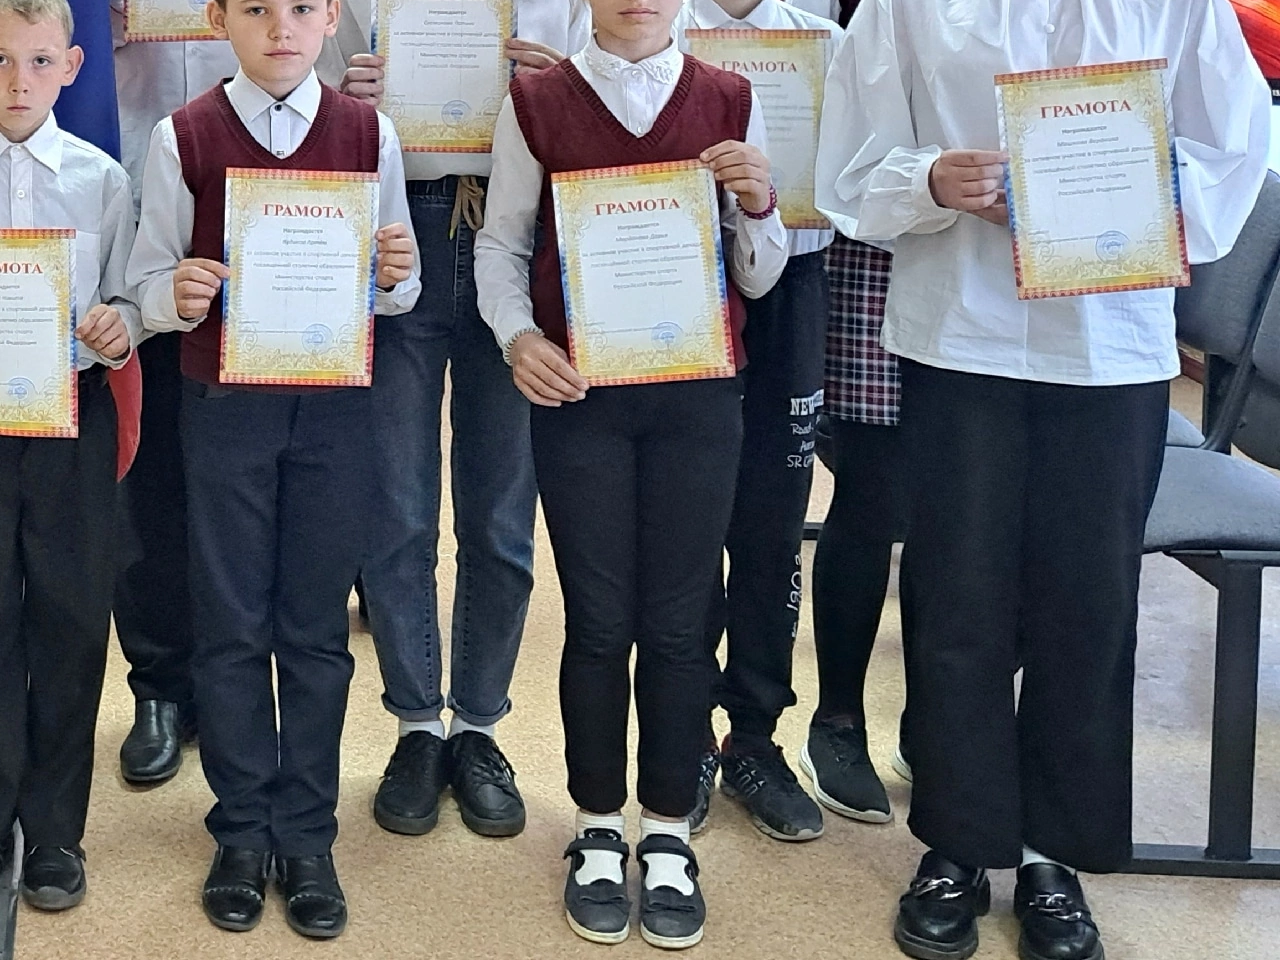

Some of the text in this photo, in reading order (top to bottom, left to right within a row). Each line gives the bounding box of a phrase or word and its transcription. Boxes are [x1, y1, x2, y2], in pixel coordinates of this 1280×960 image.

[722, 60, 798, 73] ГРАМОТА
[1040, 99, 1132, 119] ГРАМОТА
[263, 204, 344, 219] ГРАМОТА
[595, 198, 680, 216] ГРАМОТА
